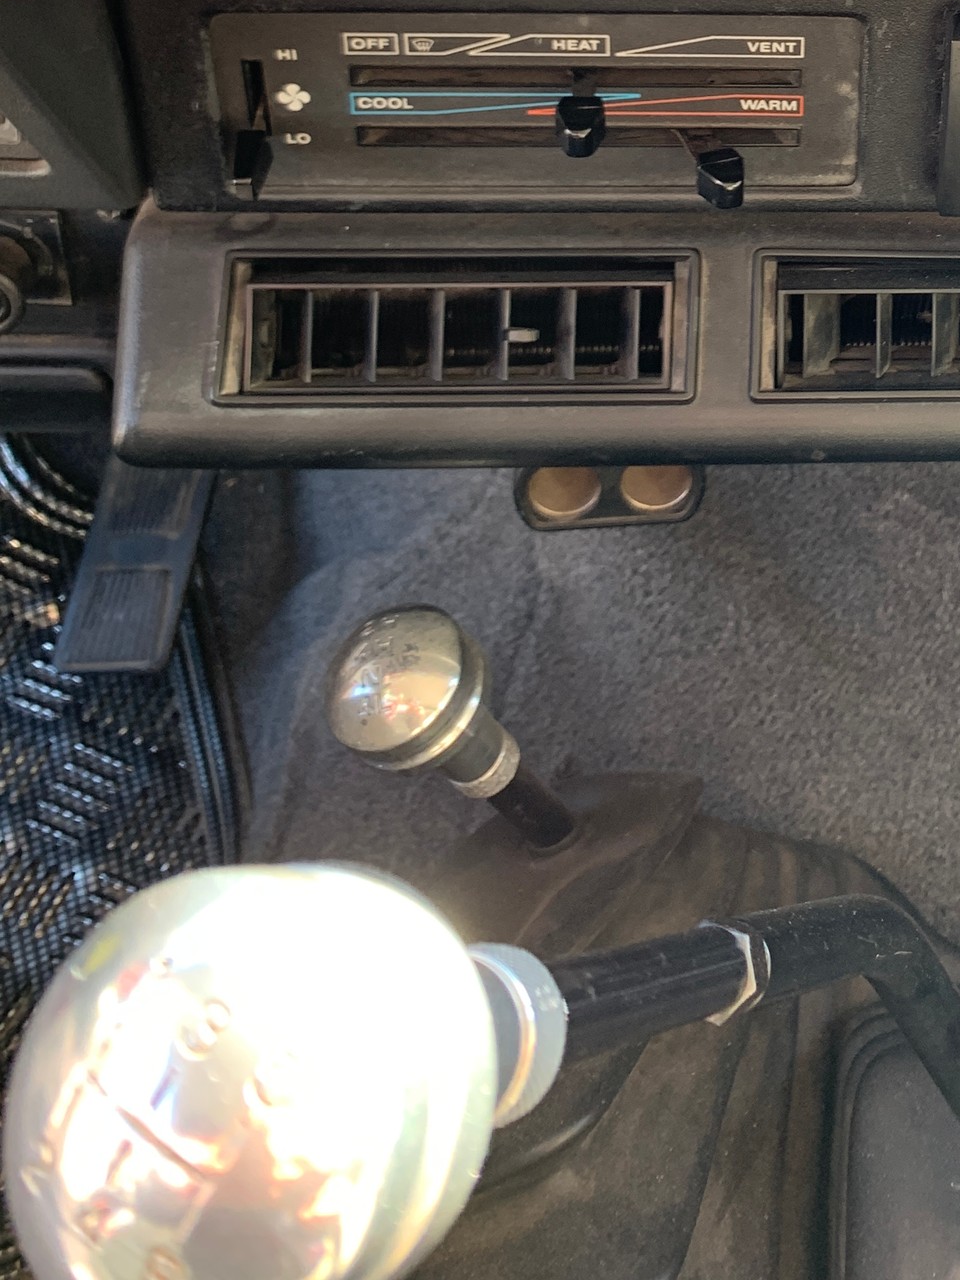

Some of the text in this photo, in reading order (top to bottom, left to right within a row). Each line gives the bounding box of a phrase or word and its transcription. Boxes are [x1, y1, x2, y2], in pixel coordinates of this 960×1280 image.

[351, 38, 390, 50] OFF
[552, 39, 600, 51] HEAT
[747, 42, 797, 53] VENT
[276, 49, 298, 61] HI
[357, 97, 414, 109] COOL
[740, 99, 797, 111] WARM
[285, 133, 311, 144] LO
